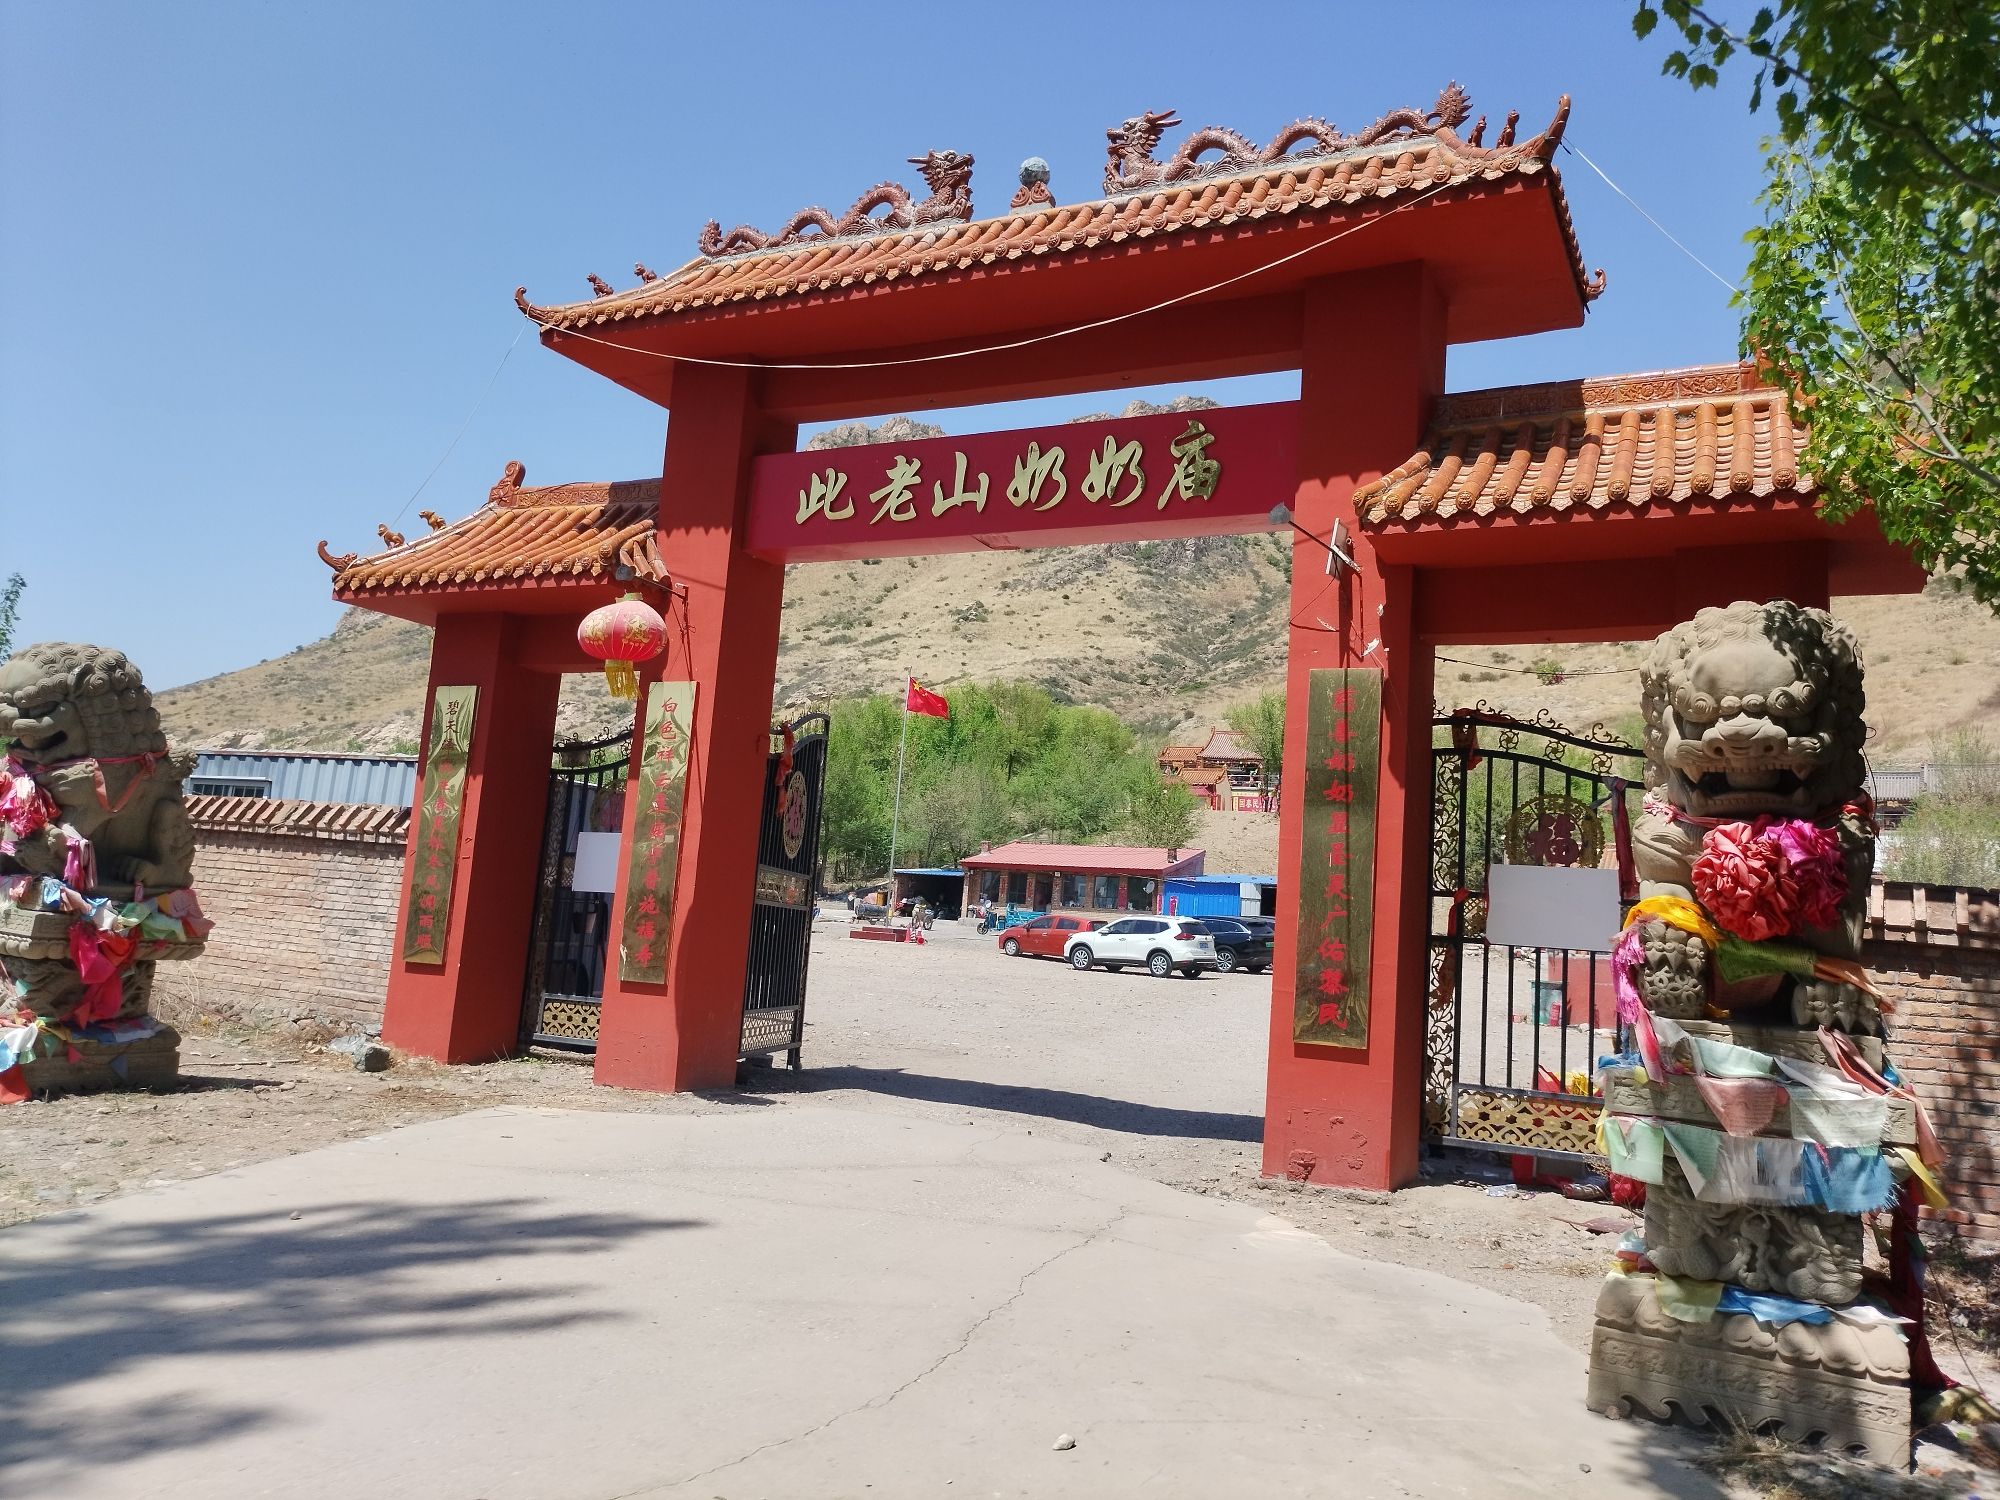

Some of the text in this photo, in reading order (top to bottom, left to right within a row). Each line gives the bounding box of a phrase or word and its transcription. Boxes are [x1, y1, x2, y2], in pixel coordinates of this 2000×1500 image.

[795, 419, 1222, 526] 此老山奶奶庙
